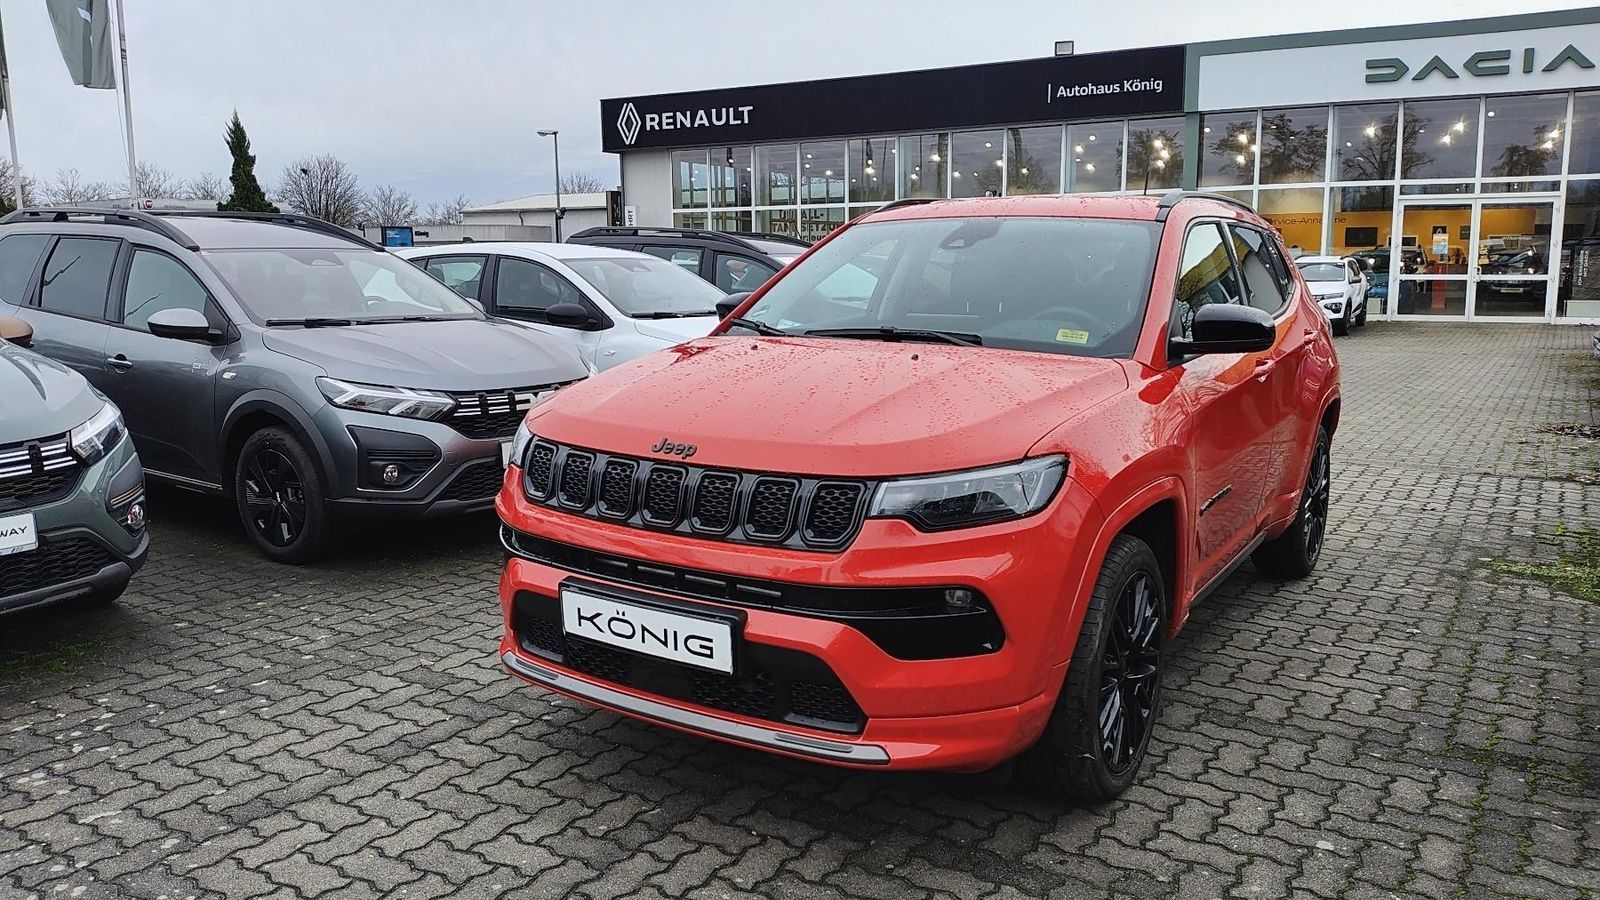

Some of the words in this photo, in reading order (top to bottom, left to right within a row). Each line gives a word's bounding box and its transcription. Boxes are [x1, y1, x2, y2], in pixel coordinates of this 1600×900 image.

[1365, 44, 1595, 83] DACIA
[1057, 83, 1120, 97] Autohaus
[1123, 78, 1162, 92] König
[645, 106, 753, 131] RENAULT
[652, 438, 697, 459] Jeep
[577, 607, 714, 659] KÖNIG
